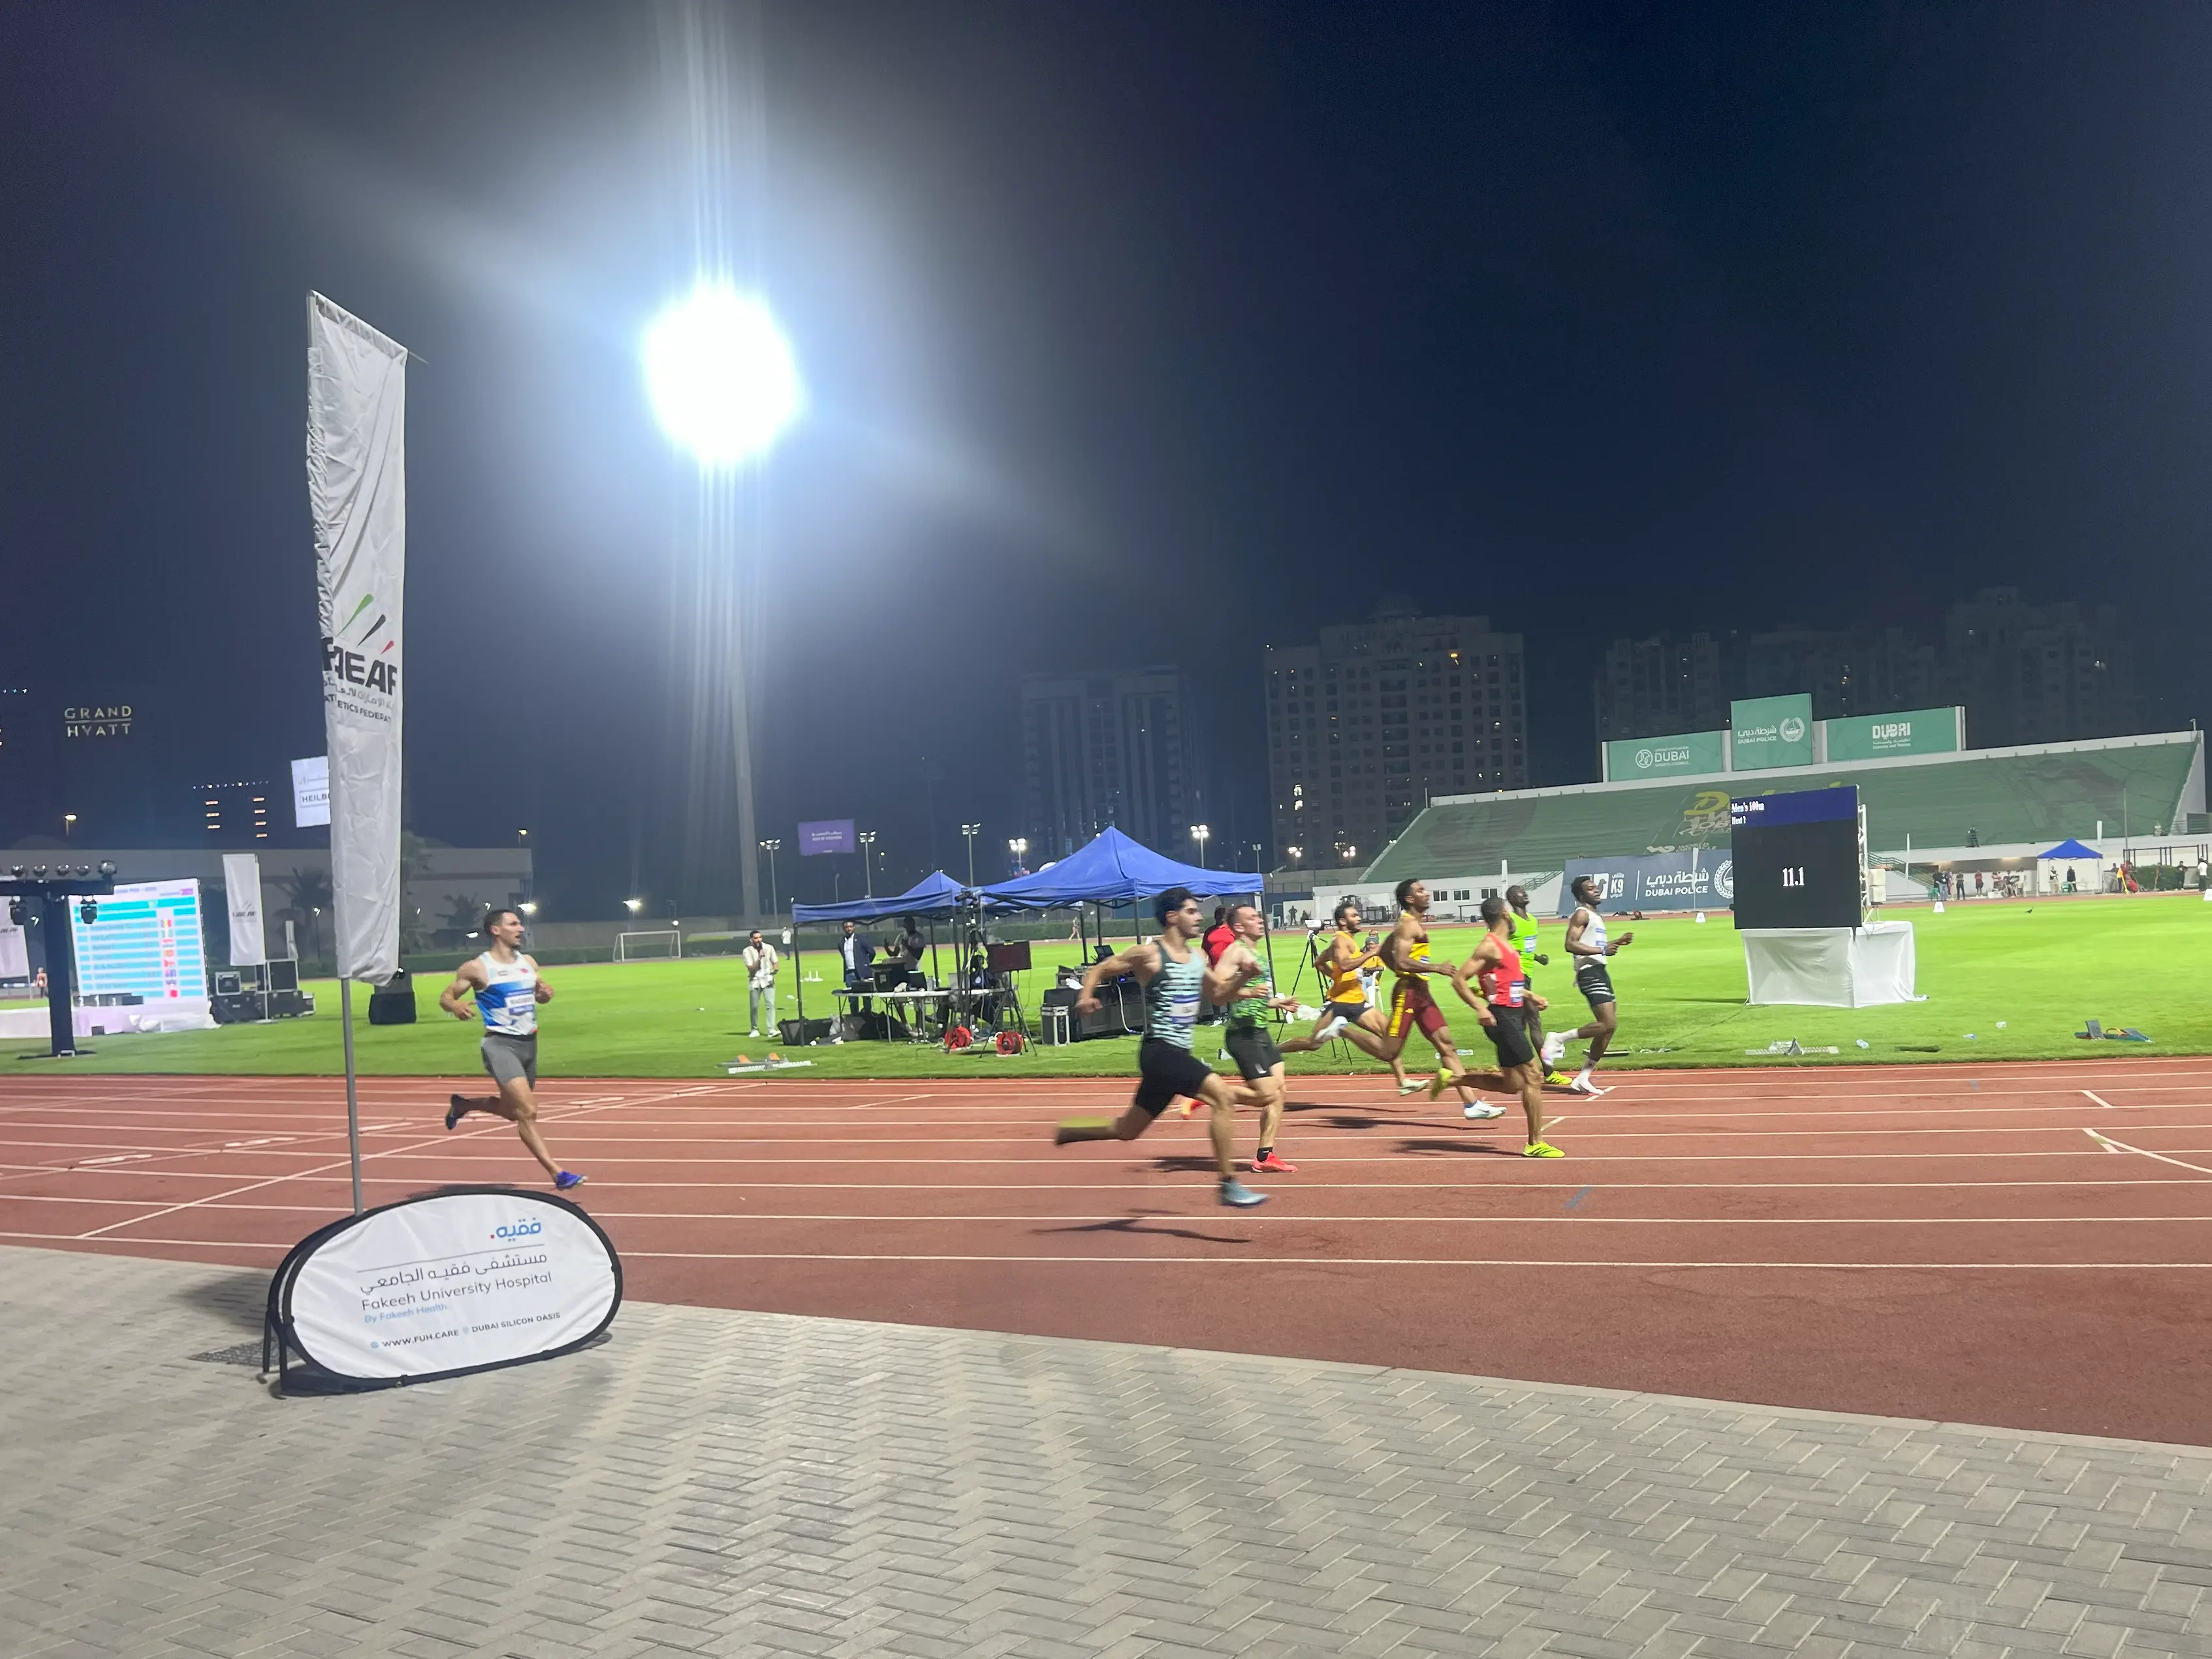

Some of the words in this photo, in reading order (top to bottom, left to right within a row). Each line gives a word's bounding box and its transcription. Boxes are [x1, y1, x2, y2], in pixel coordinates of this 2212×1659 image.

[64, 705, 132, 719] GRAND
[67, 723, 131, 737] HYATT
[1737, 729, 1754, 738] دبي
[1755, 724, 1777, 736] شرطة
[1872, 722, 1911, 740] DUBAI
[1654, 750, 1690, 763] DUBAI
[302, 793, 328, 802] HEILB
[1731, 802, 1748, 814] Men's
[1749, 800, 1765, 812] 100m
[1731, 816, 1743, 825] Heat
[1646, 874, 1673, 888] دبي
[1782, 866, 1805, 887] 11.1
[1611, 879, 1624, 894] K9
[1645, 888, 1673, 897] DUBAI
[428, 1261, 471, 1280] فقيه
[475, 1253, 547, 1275] مستشفى
[360, 1267, 424, 1295] الجامعي
[361, 1292, 416, 1311] Fakeeh
[420, 1282, 491, 1301] University
[496, 1271, 552, 1291] Hospital
[364, 1314, 377, 1324] By
[379, 1308, 414, 1321] Fakeeh
[416, 1303, 447, 1314] Health
[382, 1329, 459, 1348] WWW.FUH.CARE
[471, 1322, 499, 1333] DUBAI
[501, 1317, 534, 1329] SILICON
[536, 1312, 561, 1321] OASIS
